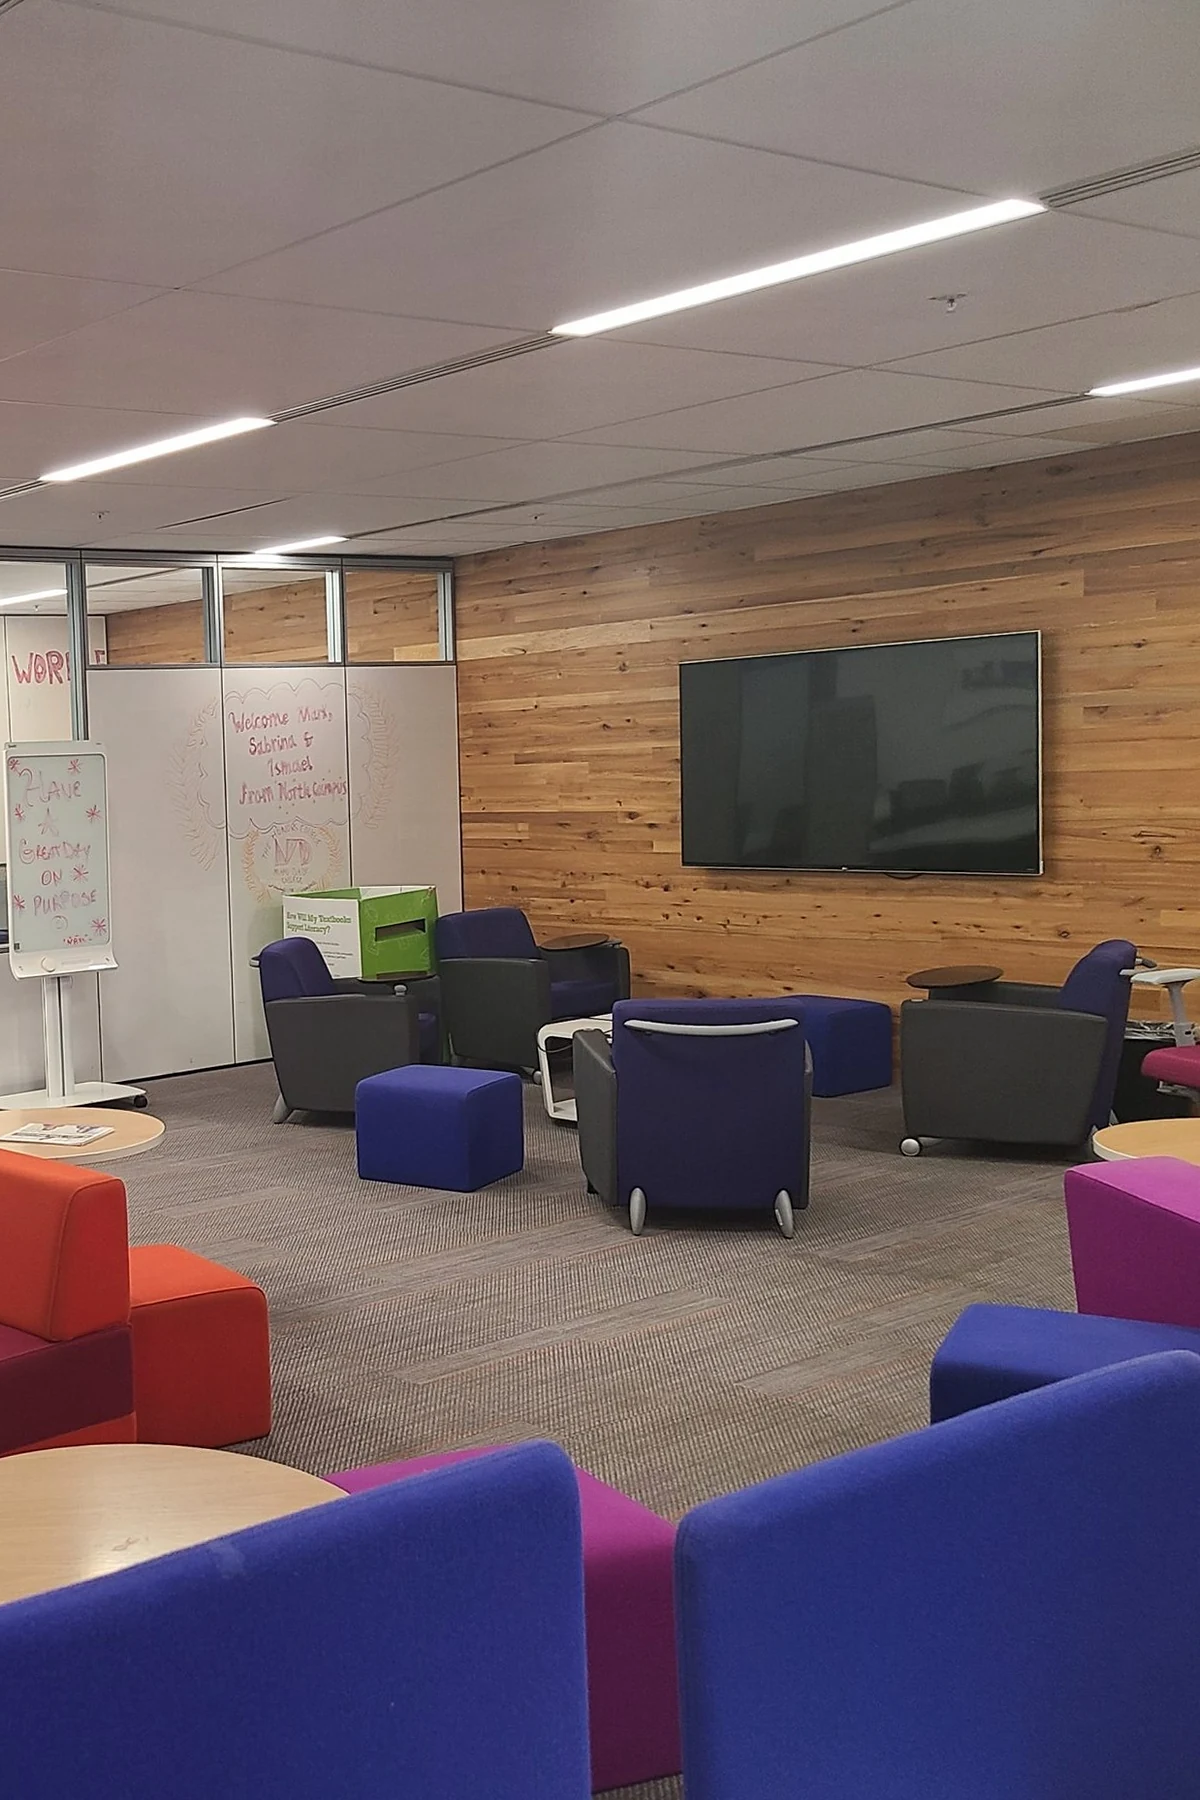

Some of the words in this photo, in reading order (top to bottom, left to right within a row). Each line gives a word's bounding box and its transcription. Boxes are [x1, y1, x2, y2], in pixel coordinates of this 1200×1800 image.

[228, 711, 289, 733] Welcome
[248, 734, 297, 755] Sabrina
[278, 781, 311, 801] North
[41, 869, 62, 886] ON
[32, 888, 97, 916] PURPOSE
[307, 914, 317, 924] My
[318, 914, 352, 924] Textbooks
